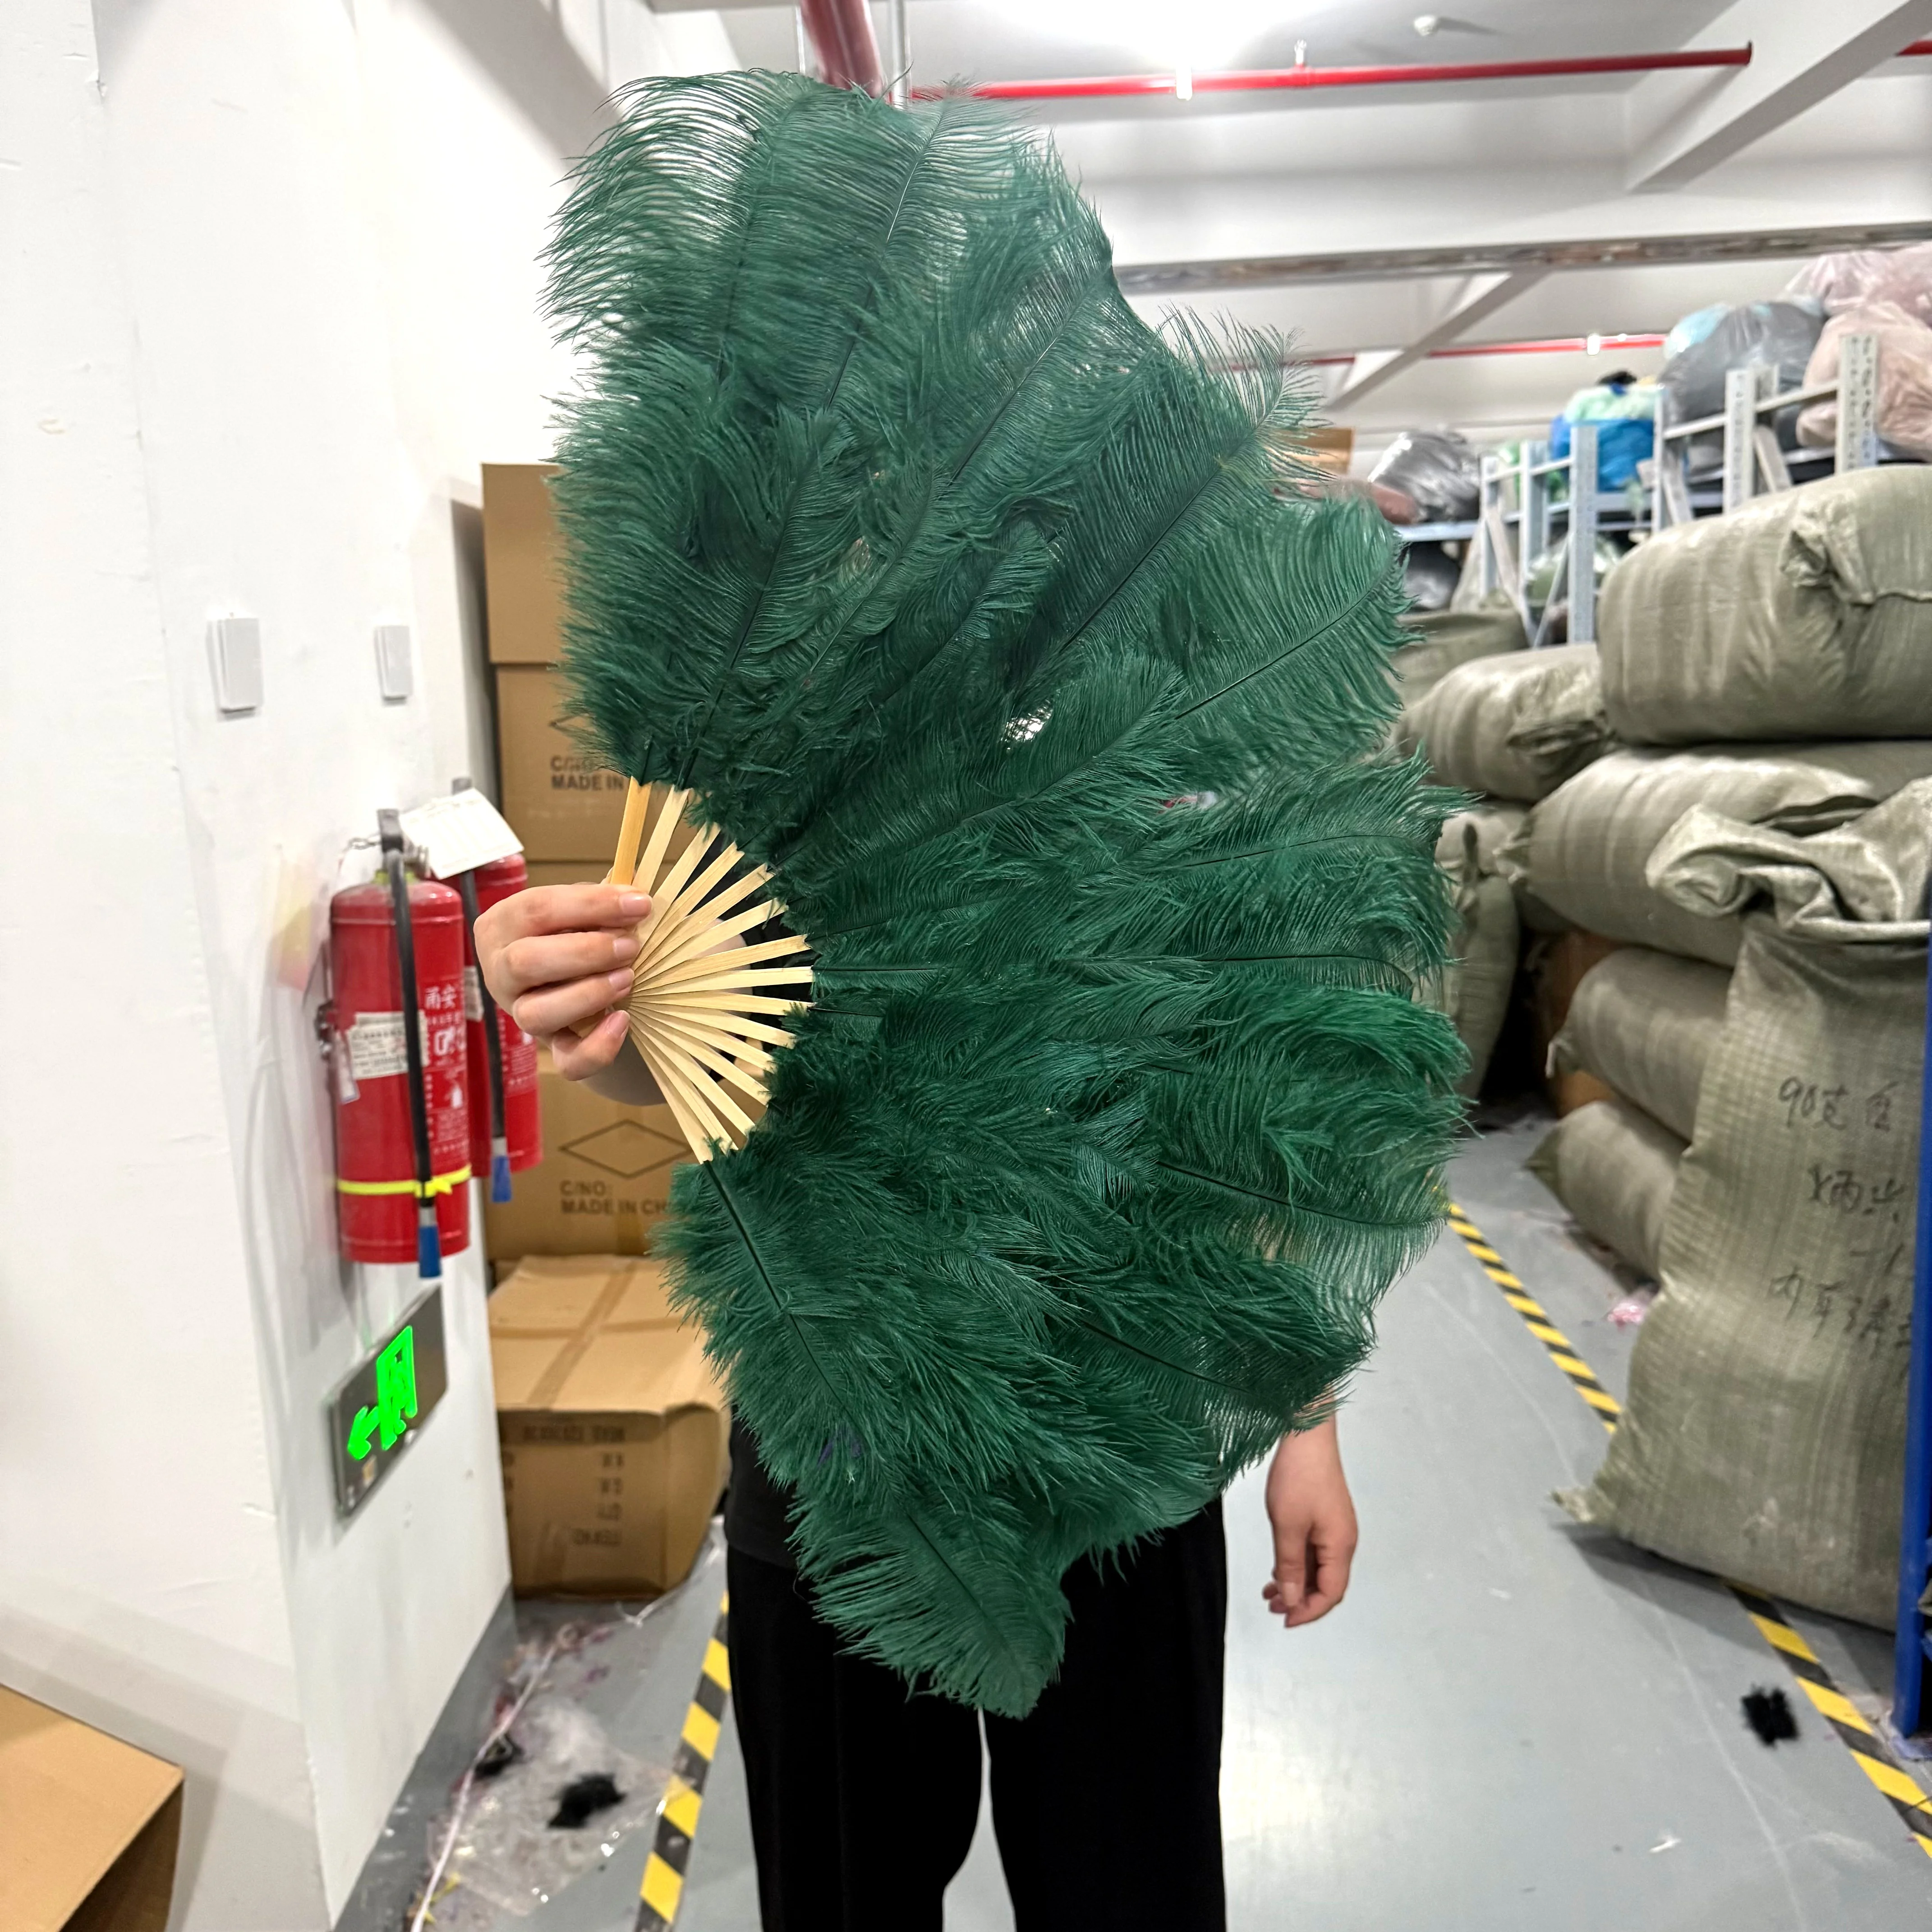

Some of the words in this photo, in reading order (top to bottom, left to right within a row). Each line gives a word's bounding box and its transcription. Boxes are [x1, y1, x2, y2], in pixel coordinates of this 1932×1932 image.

[552, 775, 602, 790] MADE
[607, 775, 624, 790] IN
[561, 1198, 612, 1214] MADE
[618, 1199, 637, 1214] IN
[641, 1198, 670, 1214] CH
